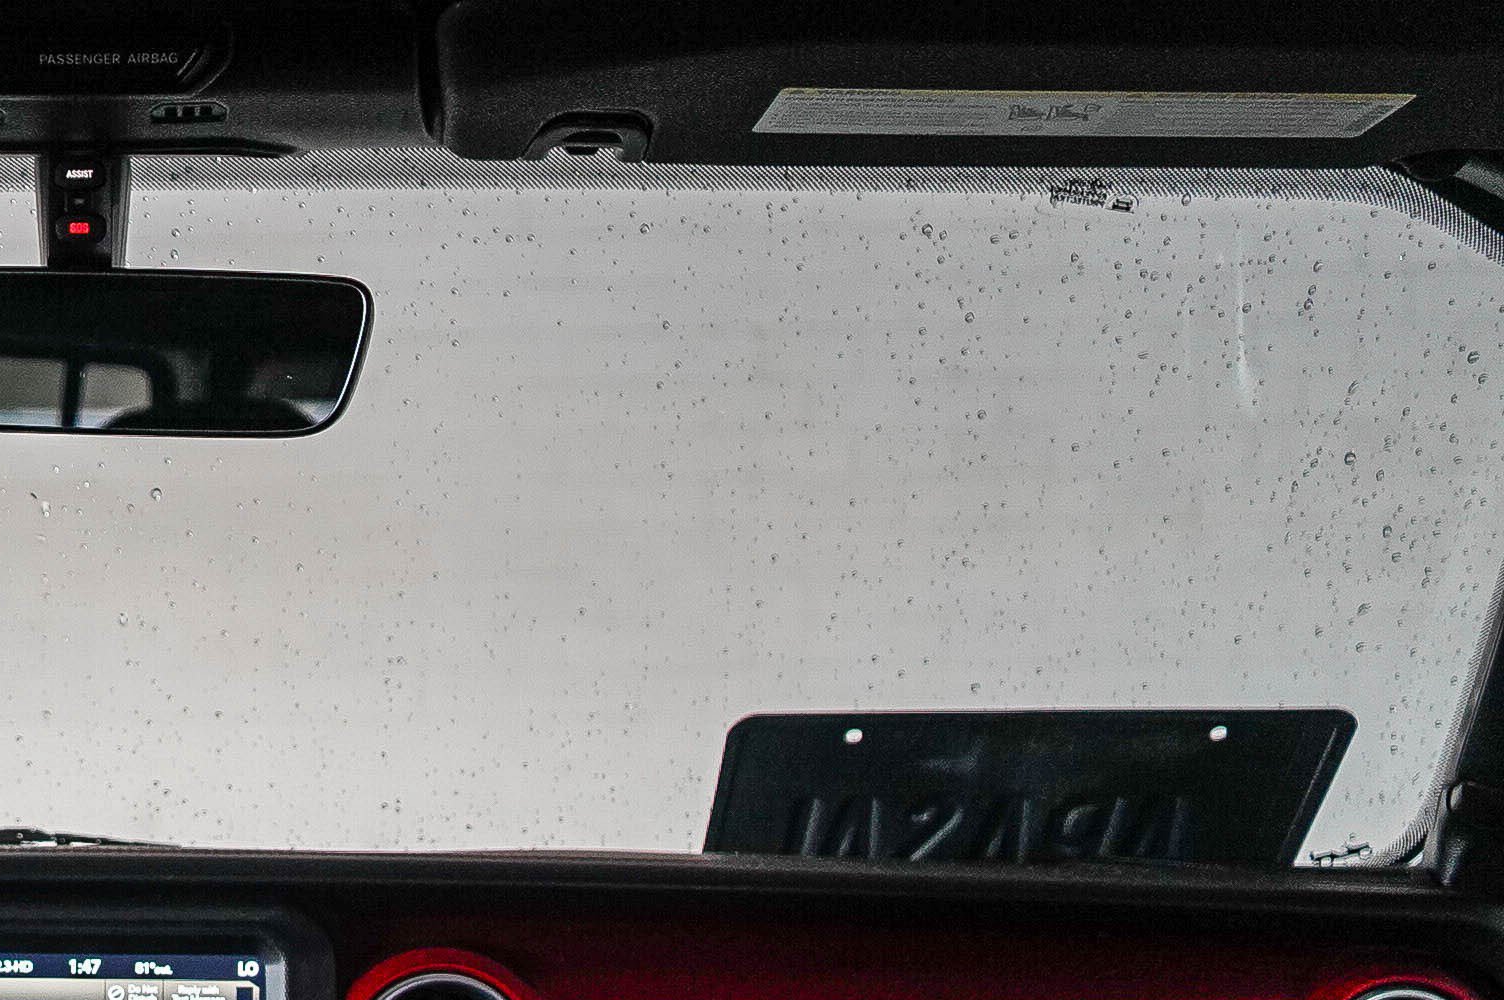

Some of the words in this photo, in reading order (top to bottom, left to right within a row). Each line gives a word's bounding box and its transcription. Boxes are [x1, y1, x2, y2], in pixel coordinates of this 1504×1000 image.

[39, 53, 121, 65] PASSENGER
[127, 52, 179, 65] AIRBAG
[65, 169, 94, 179] ASSIST
[68, 222, 90, 234] SOS
[68, 958, 102, 975] 1:47
[236, 960, 260, 977] LO
